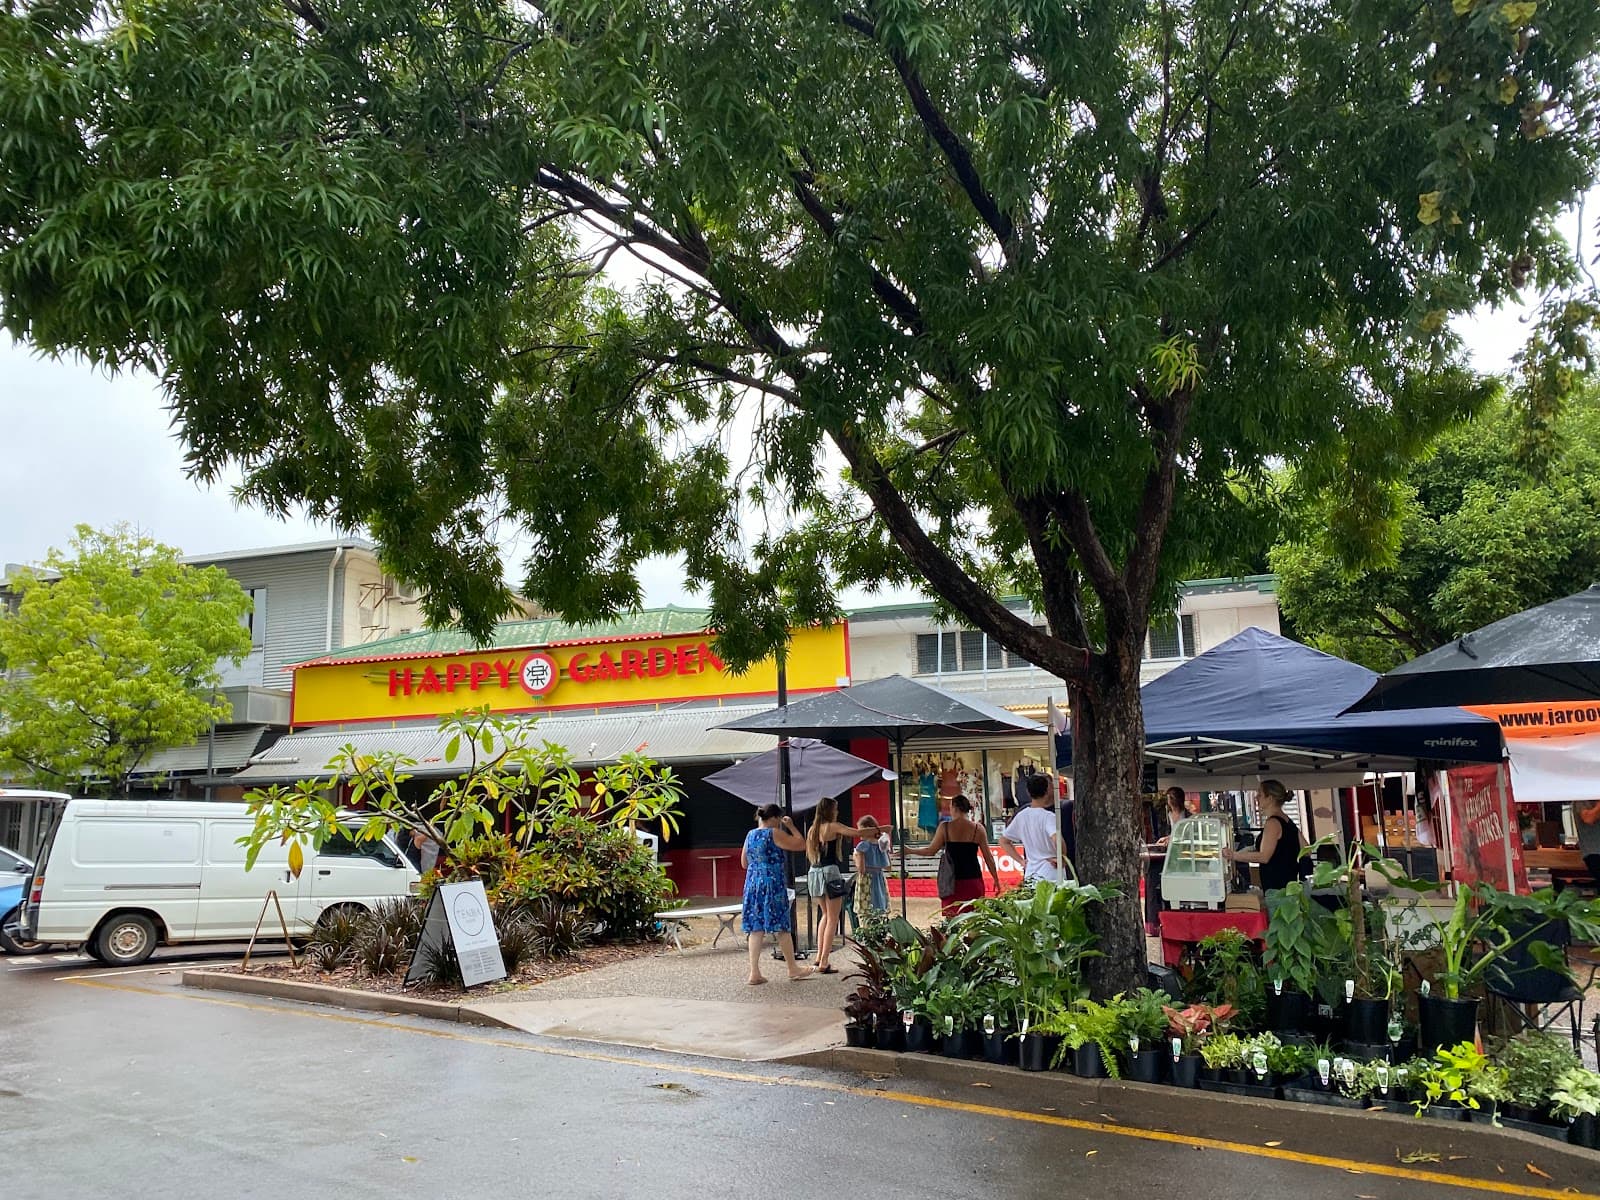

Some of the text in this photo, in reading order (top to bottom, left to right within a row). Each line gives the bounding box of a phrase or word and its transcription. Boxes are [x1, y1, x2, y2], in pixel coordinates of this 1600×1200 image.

[388, 658, 515, 697] HAPPY
[568, 642, 725, 683] GARDEN
[1499, 707, 1600, 727] www.jaroo
